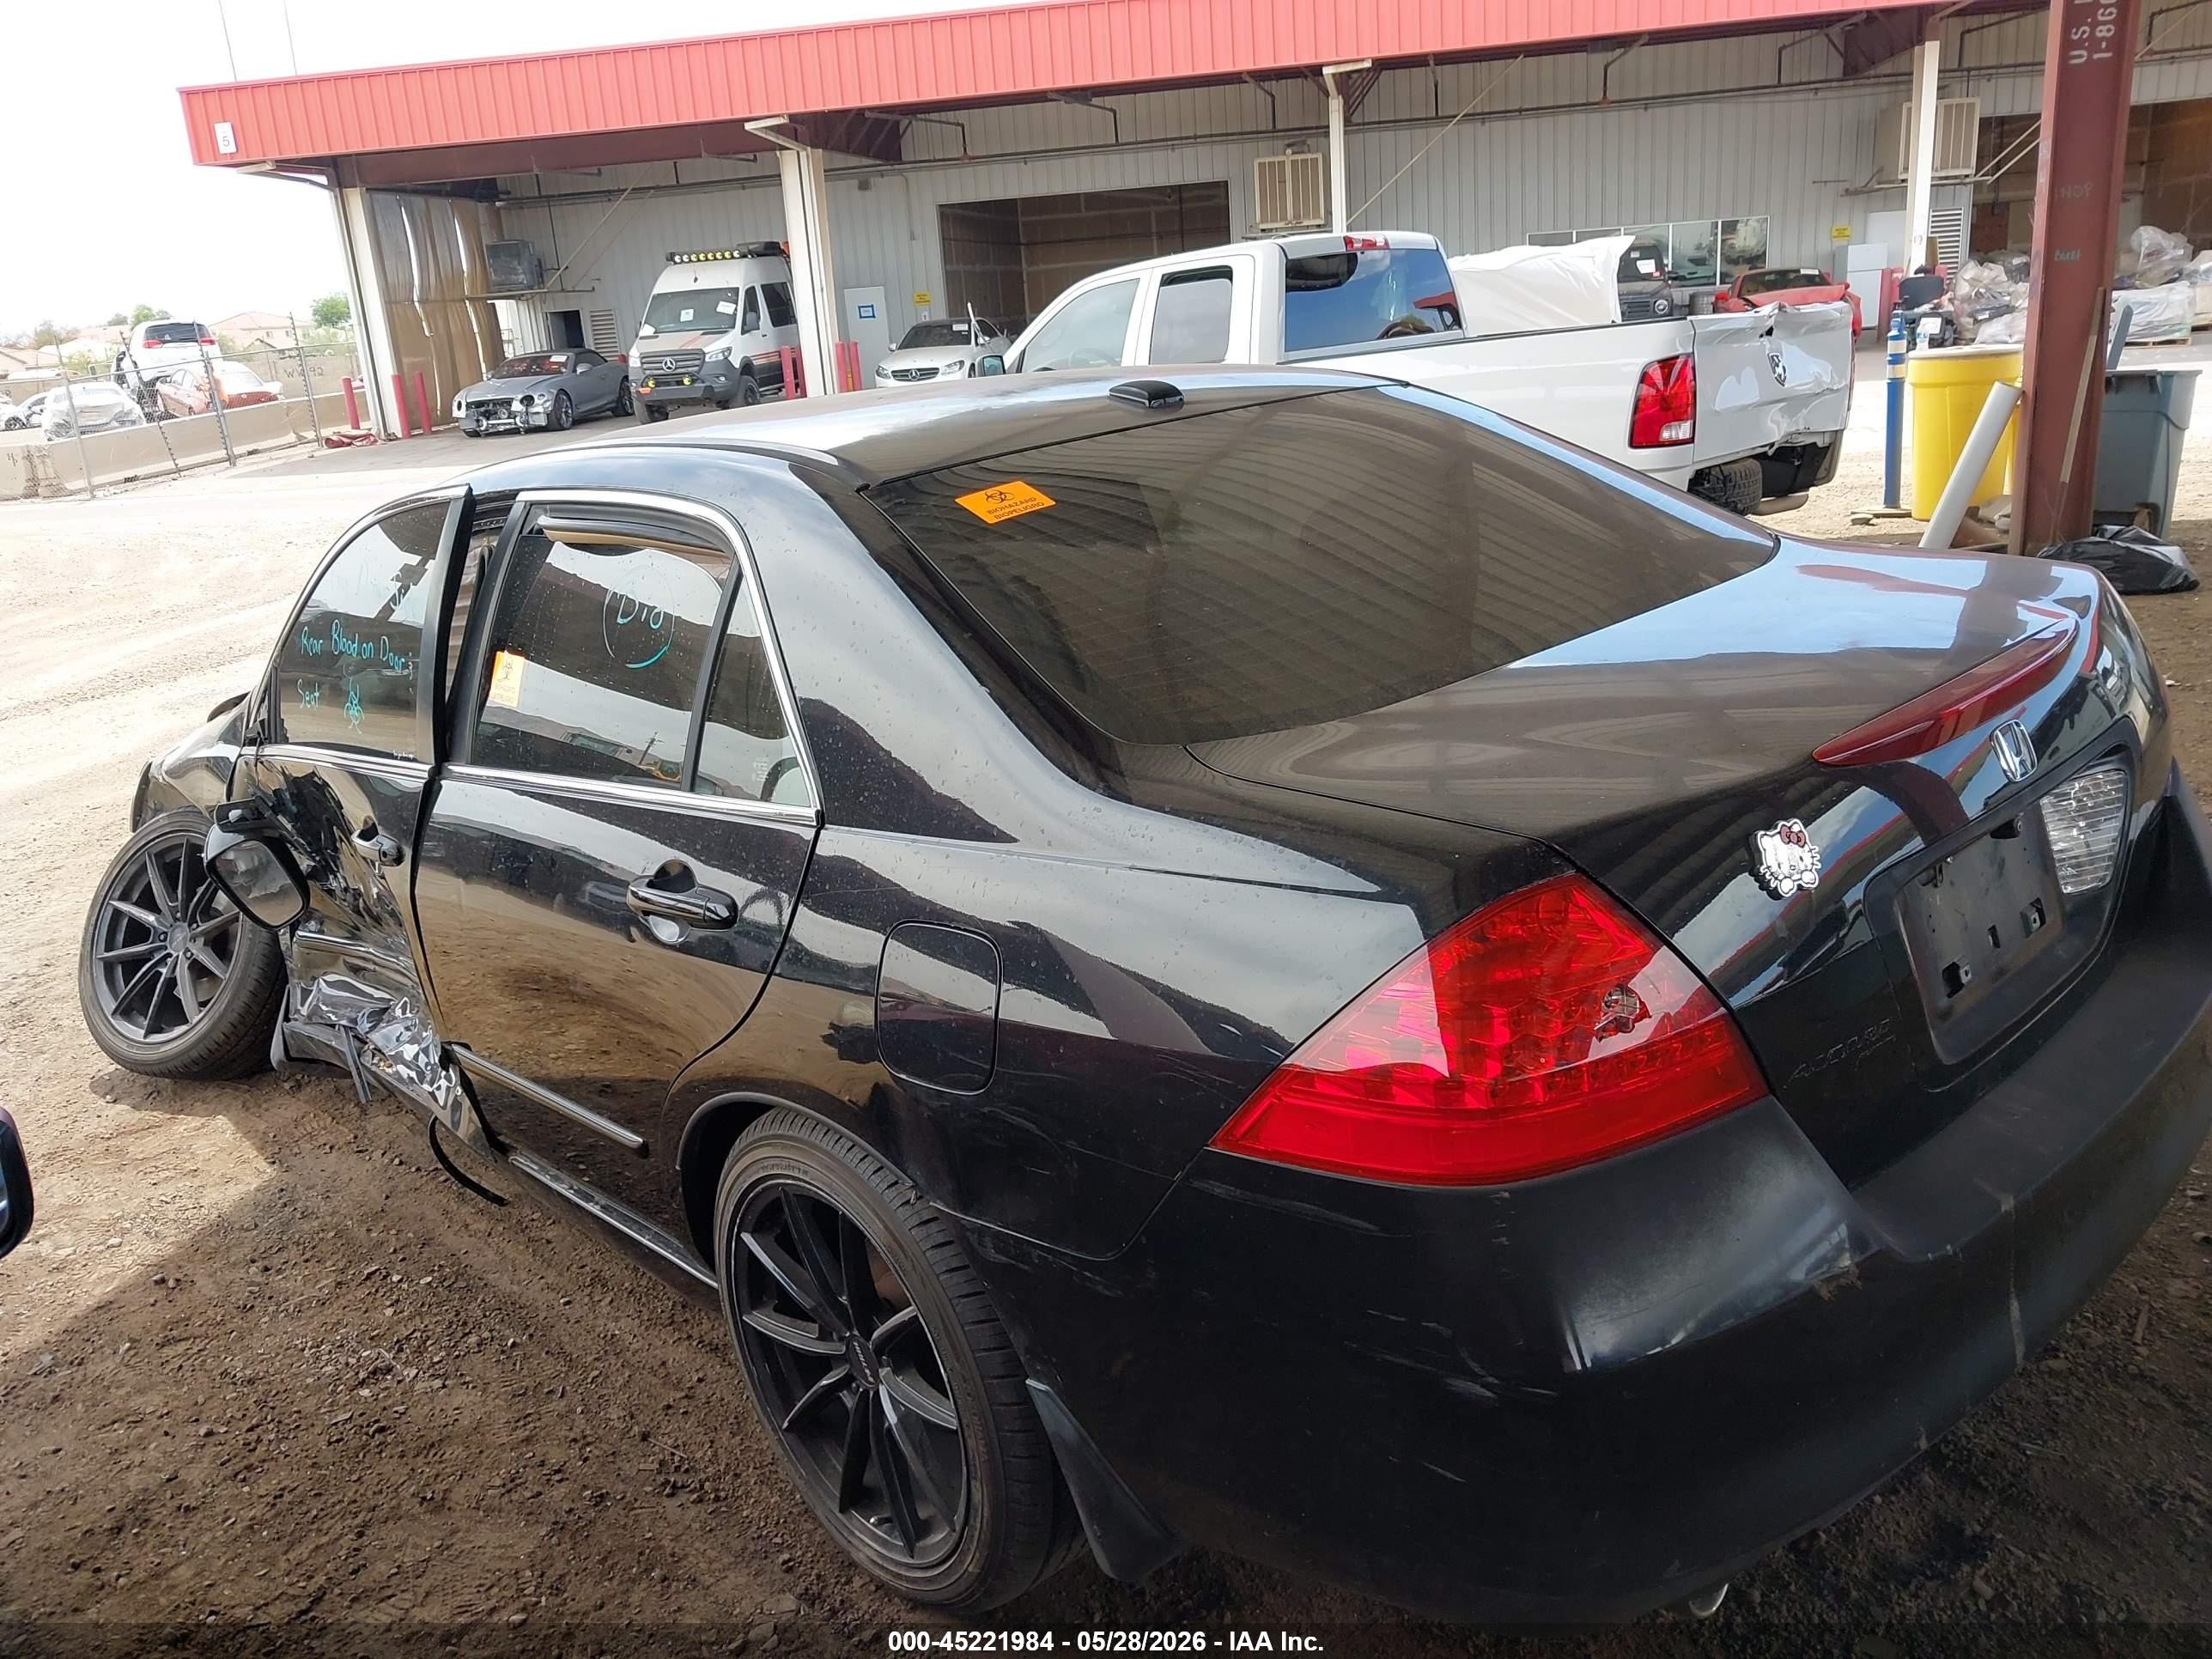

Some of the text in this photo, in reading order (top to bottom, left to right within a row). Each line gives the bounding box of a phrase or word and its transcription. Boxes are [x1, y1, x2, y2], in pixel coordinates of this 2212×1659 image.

[986, 496, 1037, 515] BIOHAZARD
[994, 501, 1045, 520] BIOPELIGRO
[301, 619, 405, 673] Rear Blood on Door
[296, 678, 319, 709] Seat
